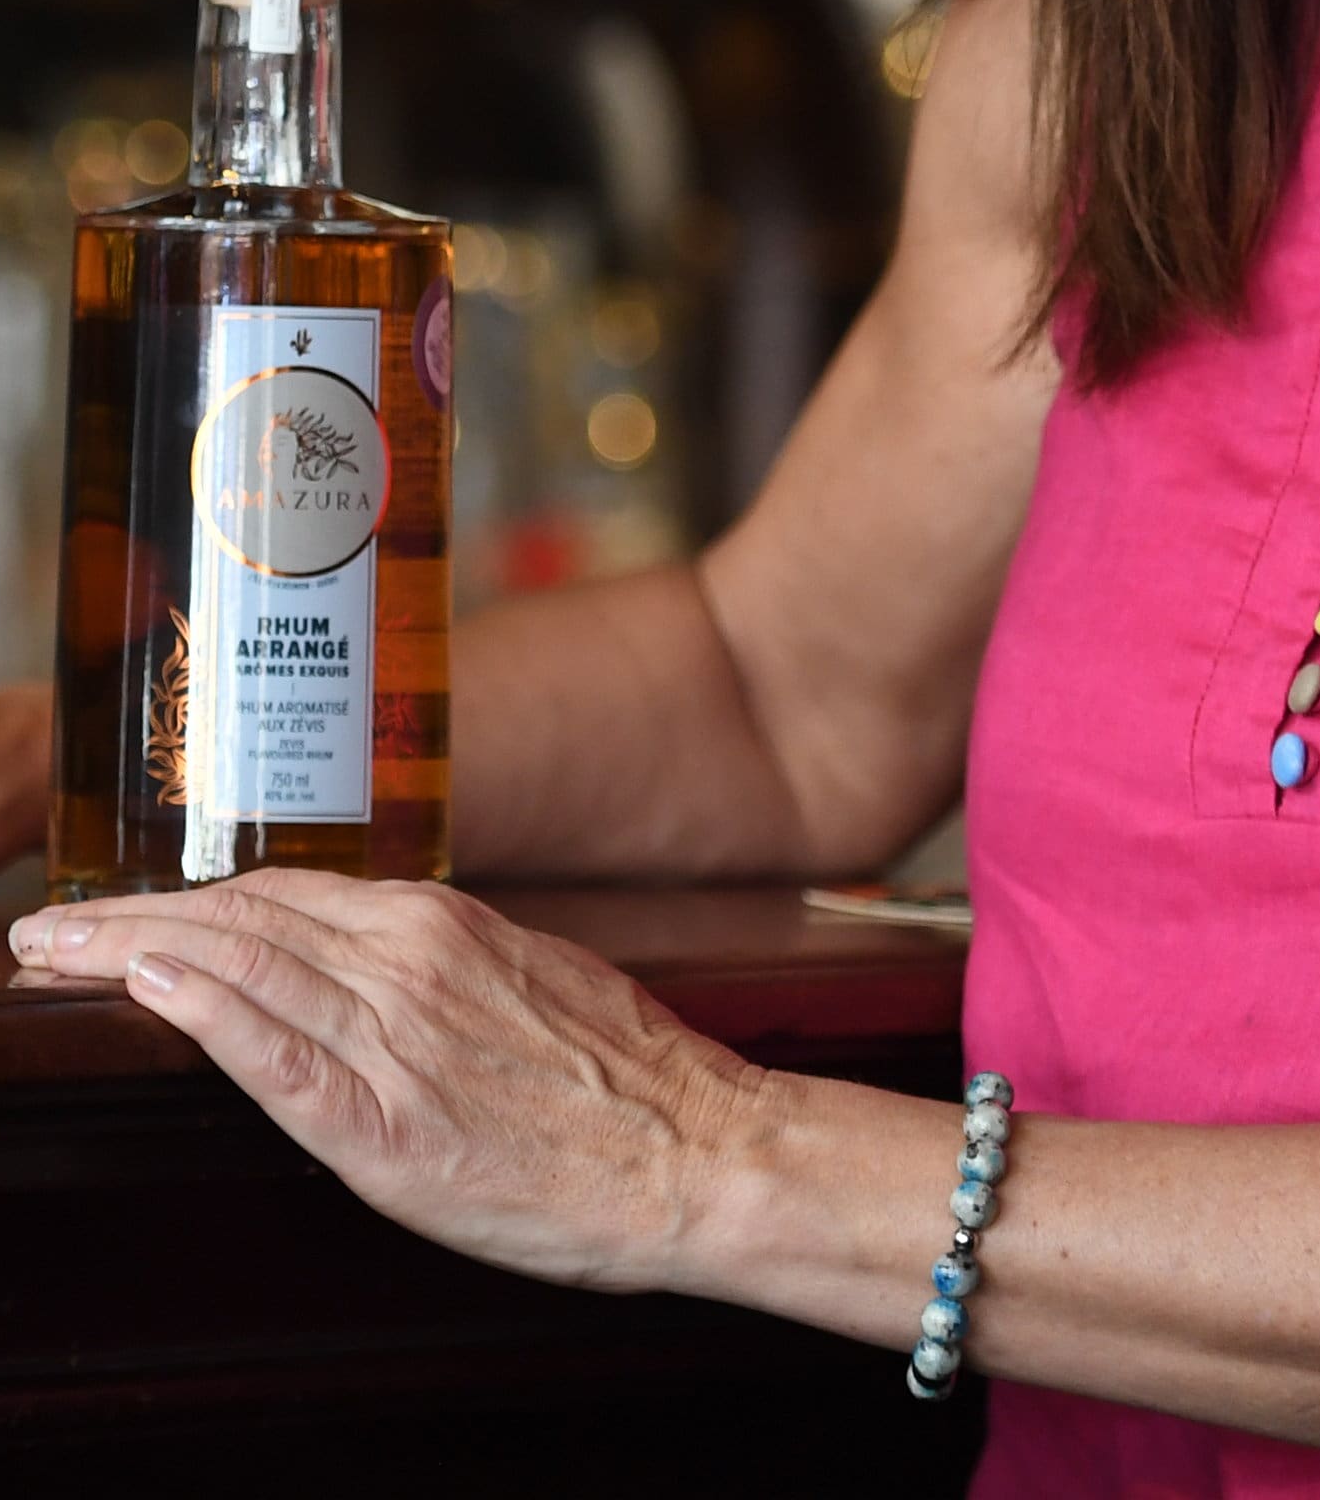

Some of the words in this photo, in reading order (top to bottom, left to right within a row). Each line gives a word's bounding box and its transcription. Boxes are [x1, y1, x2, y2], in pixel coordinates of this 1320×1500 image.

[217, 488, 371, 511] AMAZURA
[257, 617, 330, 636] RHUM
[236, 636, 349, 660] ARRANGÉ
[236, 663, 294, 677] ARÔMES
[299, 665, 349, 678] EXQUIS
[277, 698, 349, 716] AROMATISÉ
[258, 719, 286, 733] AUX
[271, 771, 292, 789] 750
[295, 773, 310, 788] ml
